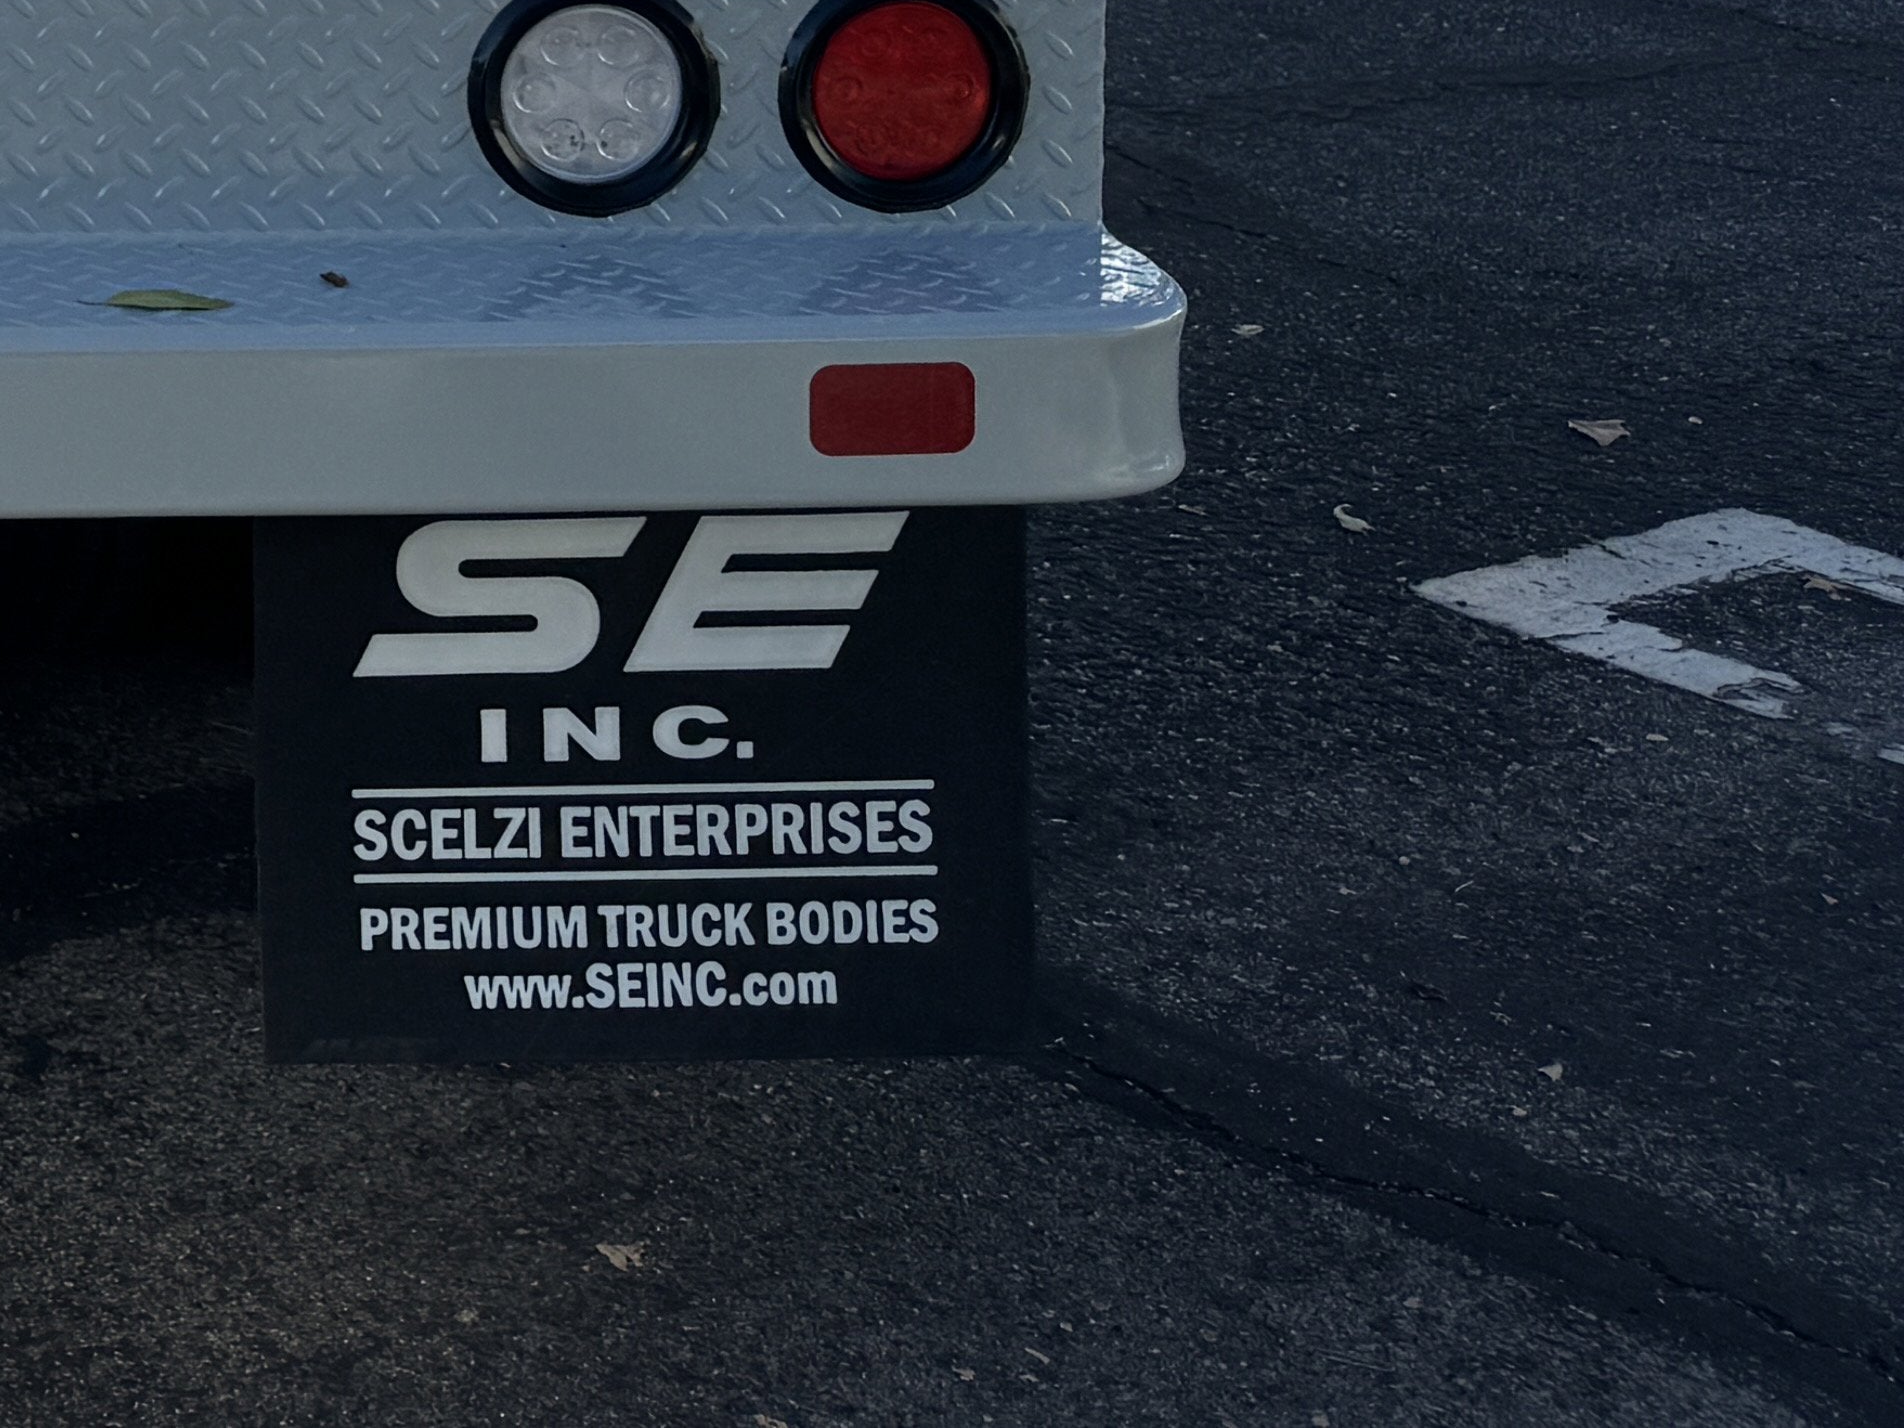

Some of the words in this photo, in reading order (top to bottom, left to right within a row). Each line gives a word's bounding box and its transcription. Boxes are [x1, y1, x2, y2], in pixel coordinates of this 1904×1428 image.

[352, 510, 910, 677] SE
[479, 704, 755, 763] INC.
[352, 806, 543, 861] SCELZI
[560, 798, 934, 858] ENTERPRISES
[359, 904, 589, 951] PREMIUM
[596, 901, 754, 948] TRUCK
[765, 897, 939, 946] BODIES
[462, 961, 838, 1011] www.SEINC.com
